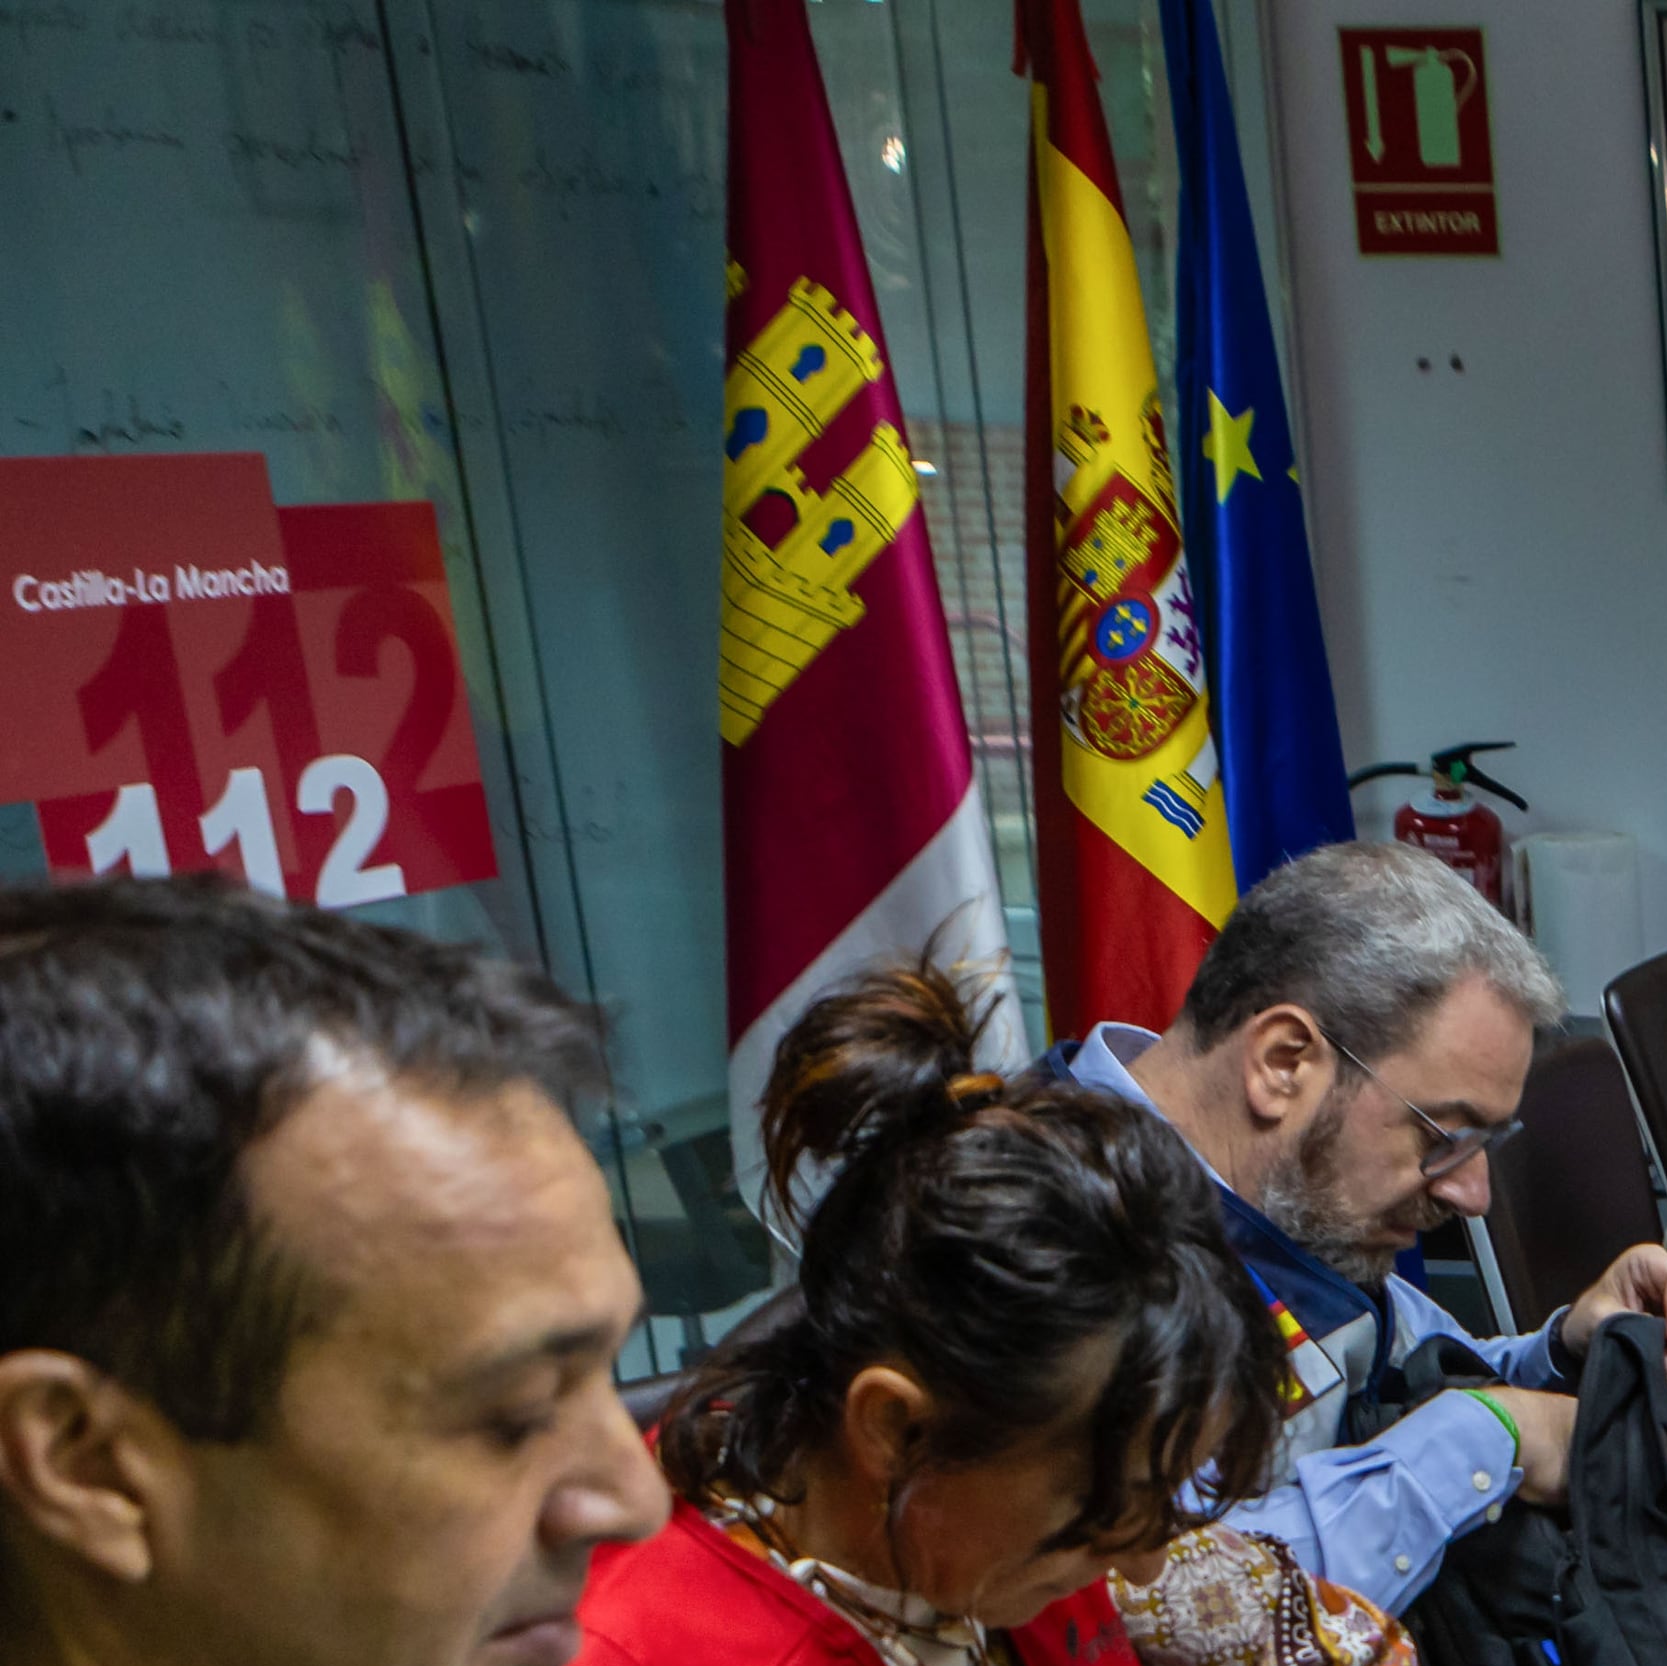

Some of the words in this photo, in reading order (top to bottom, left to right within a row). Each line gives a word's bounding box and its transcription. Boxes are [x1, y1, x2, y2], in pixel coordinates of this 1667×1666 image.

[1373, 210, 1481, 235] EXTINTOR
[13, 567, 171, 612] Castilla-La
[173, 557, 290, 600] Mancha
[84, 754, 408, 912] 112
